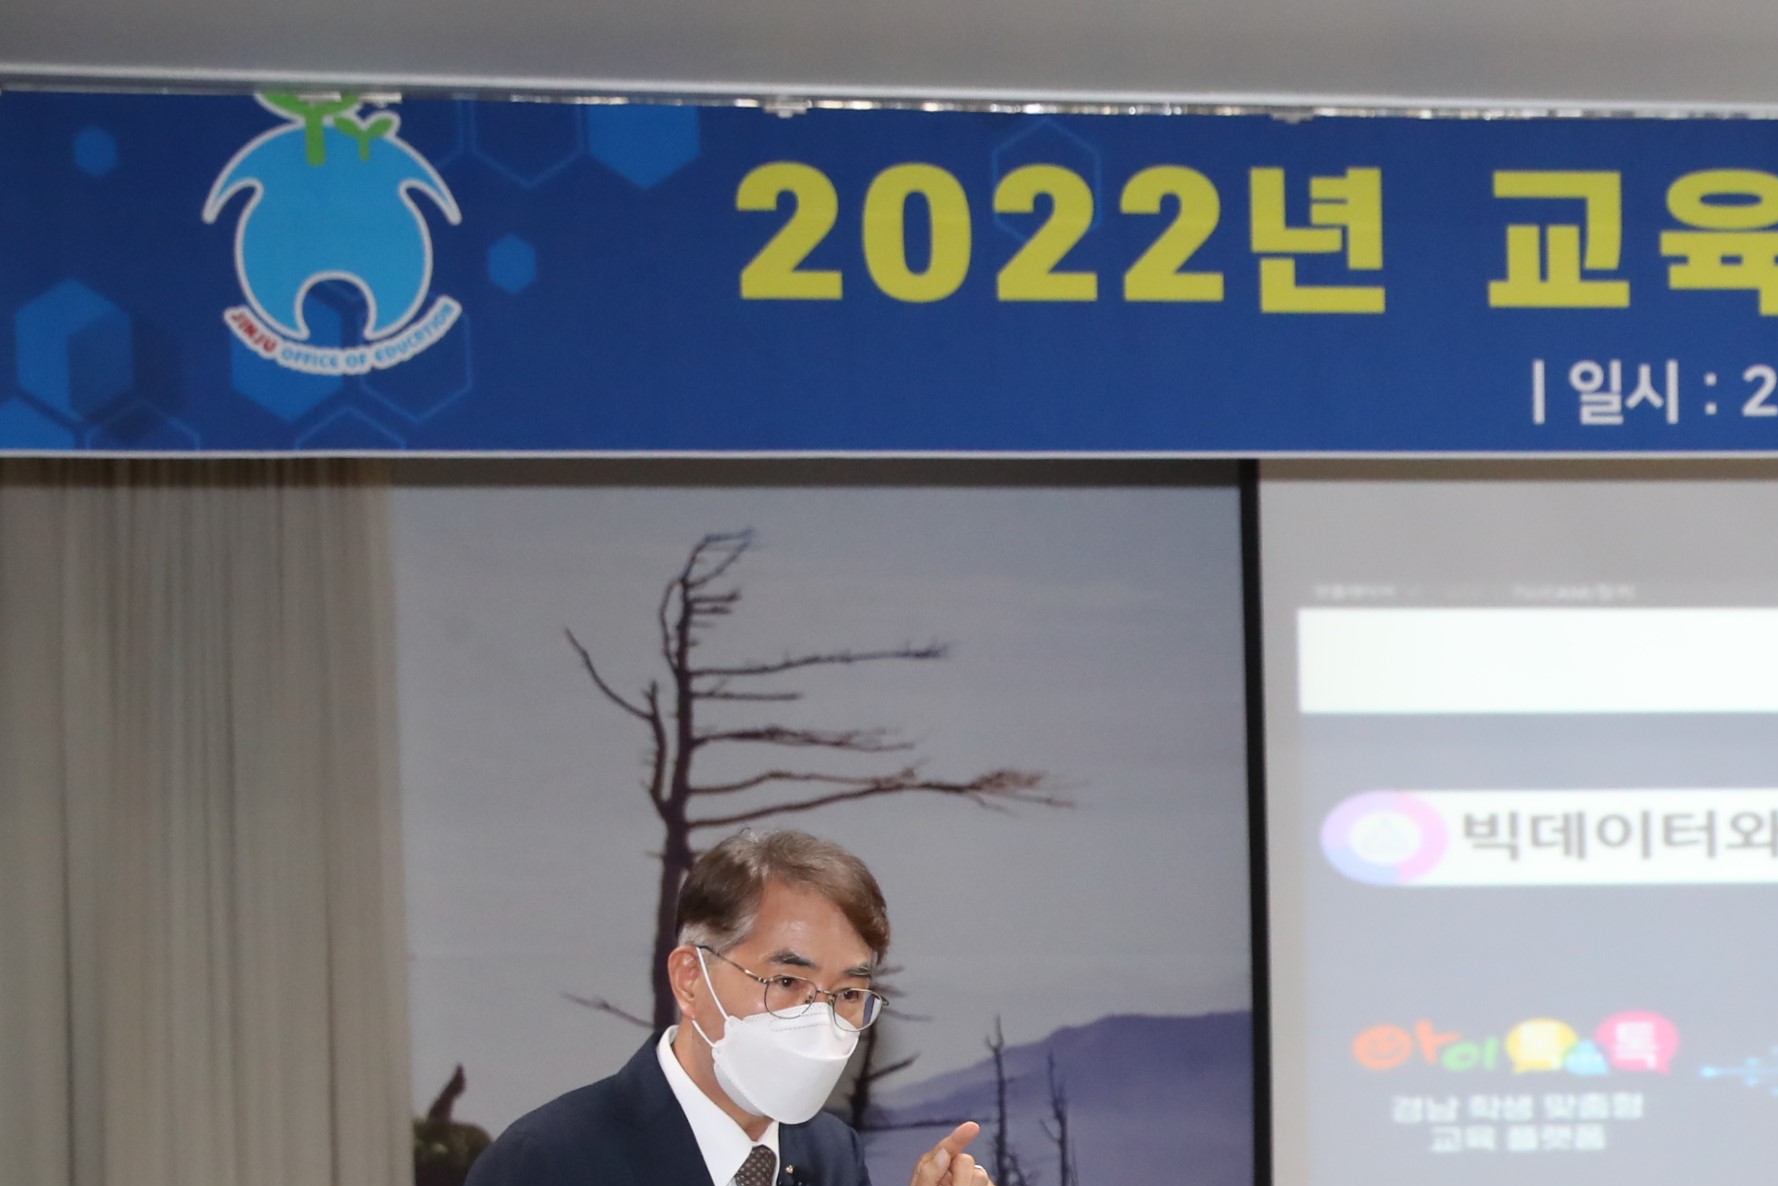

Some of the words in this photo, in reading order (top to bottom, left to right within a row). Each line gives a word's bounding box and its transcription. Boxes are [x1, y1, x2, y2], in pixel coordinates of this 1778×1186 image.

[736, 161, 1386, 314] 2022년
[231, 312, 277, 353] JINJU
[281, 349, 339, 368] OFFICE
[345, 351, 367, 367] OF
[374, 301, 455, 362] EDUCATION
[1567, 360, 1680, 425] 일시
